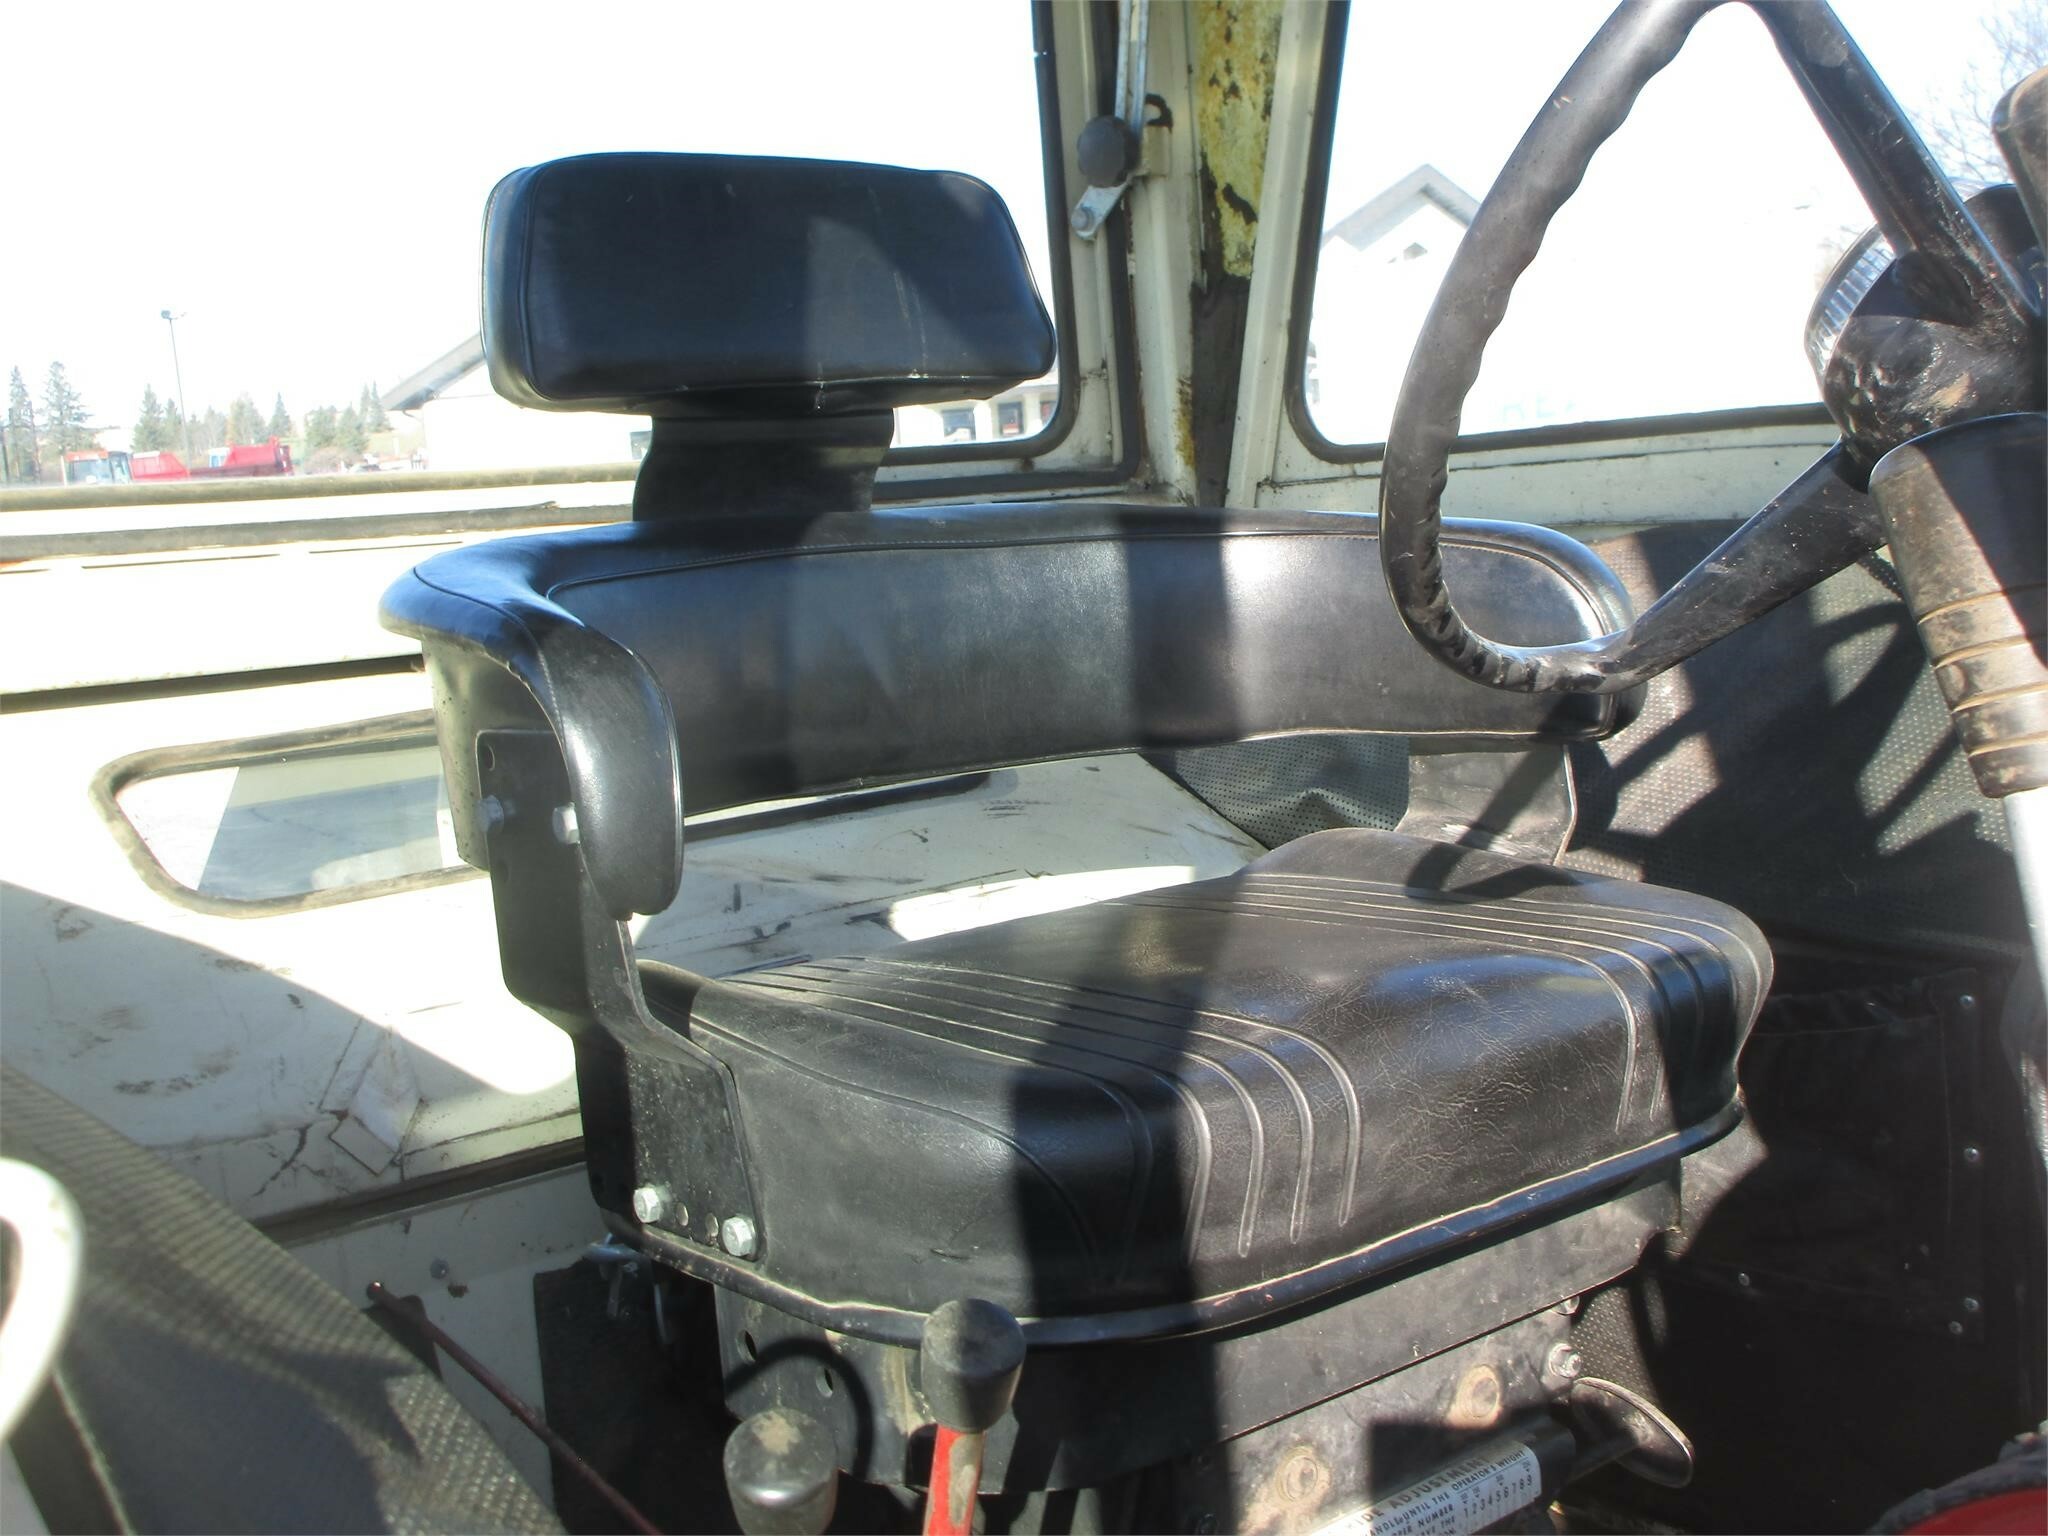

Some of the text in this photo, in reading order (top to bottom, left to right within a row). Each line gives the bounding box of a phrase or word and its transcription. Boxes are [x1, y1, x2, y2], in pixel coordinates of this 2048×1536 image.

[1388, 1457, 1490, 1510] ADJUSTMENT
[1402, 1502, 1431, 1520] UNTIL
[1431, 1491, 1451, 1505] THE
[1418, 1503, 1453, 1528] NUMBER
